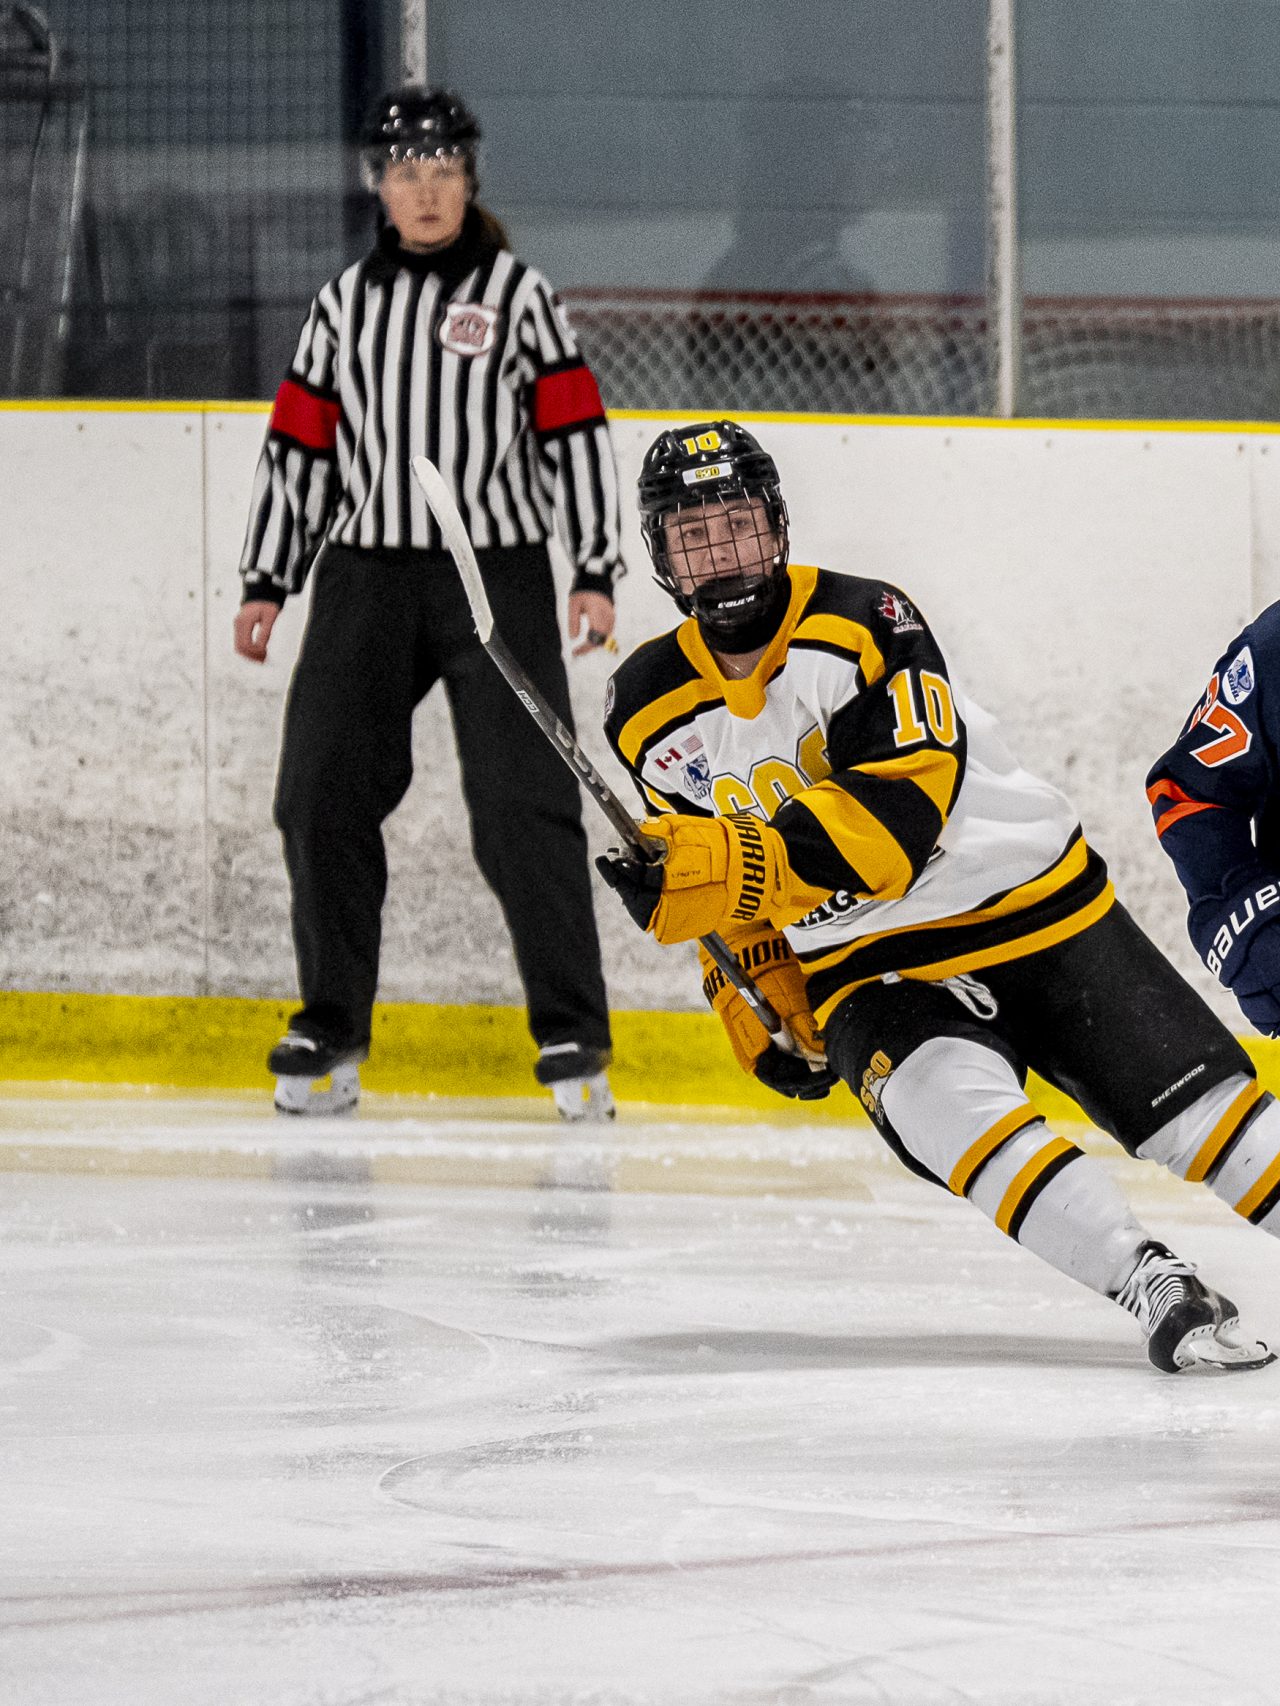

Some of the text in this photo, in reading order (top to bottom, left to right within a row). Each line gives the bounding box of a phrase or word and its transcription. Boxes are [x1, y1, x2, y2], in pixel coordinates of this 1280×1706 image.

[682, 430, 721, 456] 10
[887, 668, 958, 748] 10
[722, 812, 766, 921] WARRIOR
[1150, 1063, 1206, 1109] SHERWOOD
